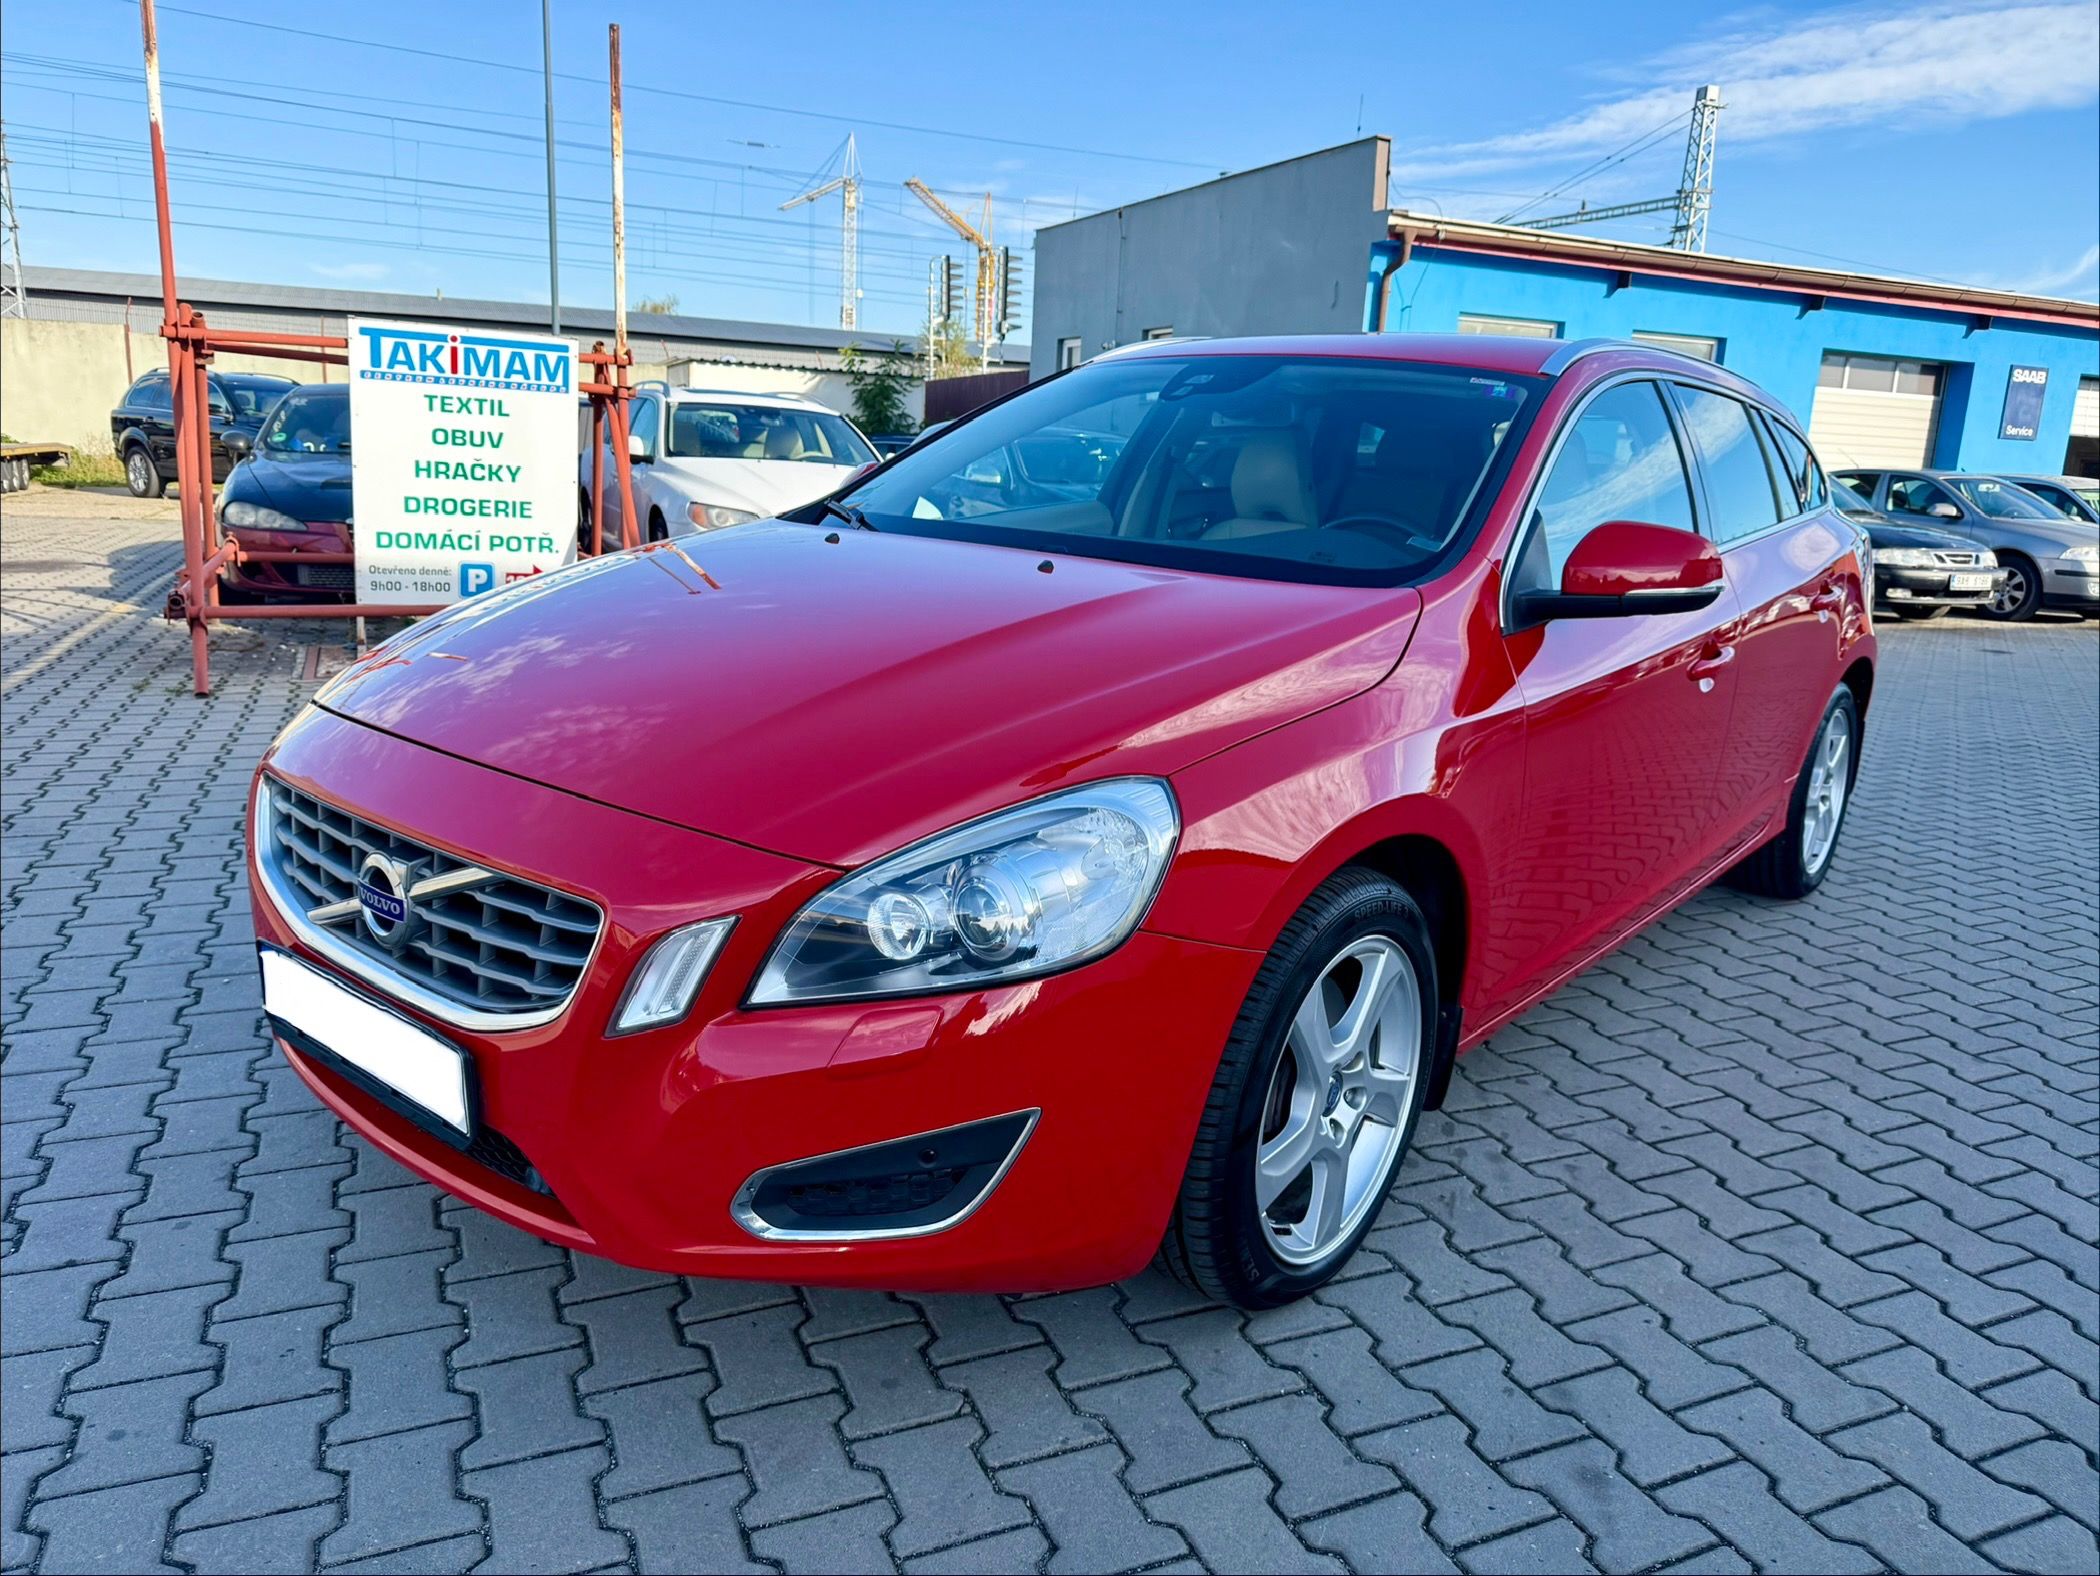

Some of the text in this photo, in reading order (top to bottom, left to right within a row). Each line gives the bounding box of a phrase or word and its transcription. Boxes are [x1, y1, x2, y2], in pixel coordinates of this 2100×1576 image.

[2012, 369, 2047, 385] SAAB
[424, 394, 510, 417] TEXTIL
[431, 428, 504, 449] OBUV
[2005, 424, 2034, 437] Service
[414, 458, 521, 483] HRAČKY
[403, 496, 533, 519] DROGERIE
[375, 529, 559, 554] DOMÁCÍ POTŘ.
[368, 565, 417, 576] Otevřeno
[370, 580, 402, 592] 9h00
[412, 581, 451, 593] 18h00
[360, 887, 401, 915] VOLVO
